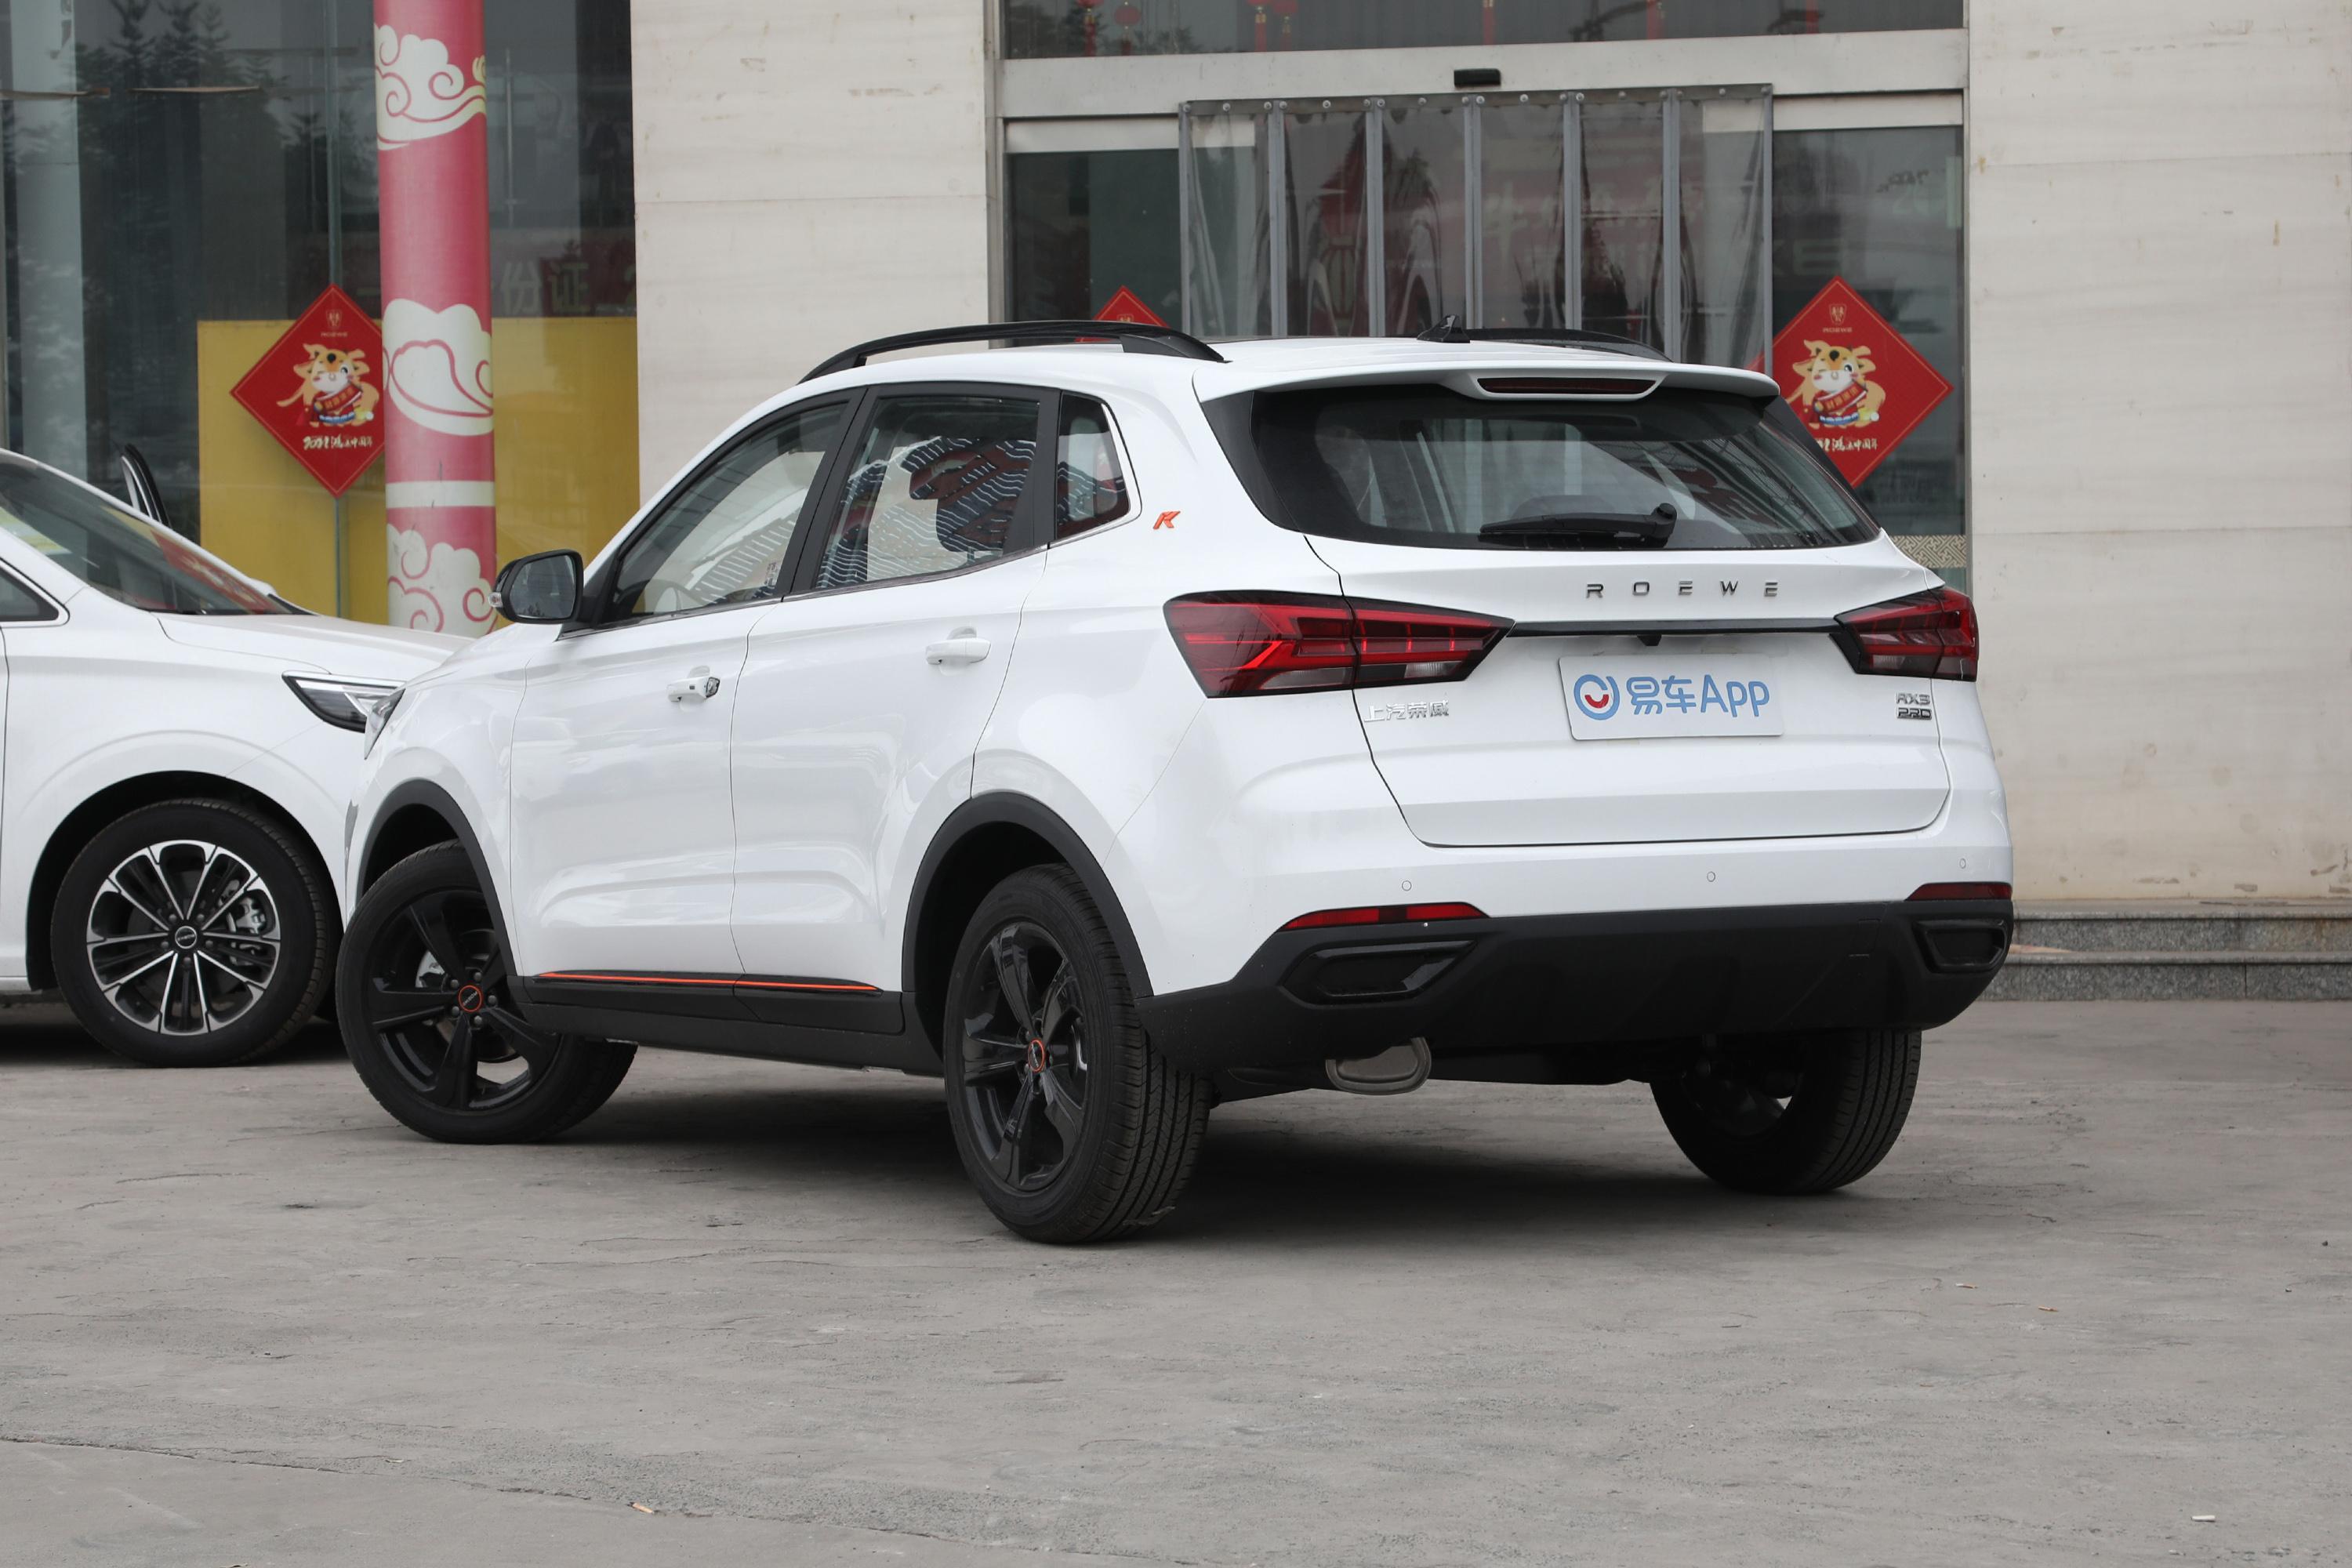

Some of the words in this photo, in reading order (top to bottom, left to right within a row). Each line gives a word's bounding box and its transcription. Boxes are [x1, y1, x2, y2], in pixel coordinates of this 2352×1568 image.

[1153, 510, 1181, 530] K
[1586, 580, 1778, 598] ROEWE
[1626, 674, 1770, 717] 易车App
[1896, 693, 1930, 706] RX3
[1363, 699, 1450, 722] 上汽荣威
[1897, 707, 1933, 720] PRO
